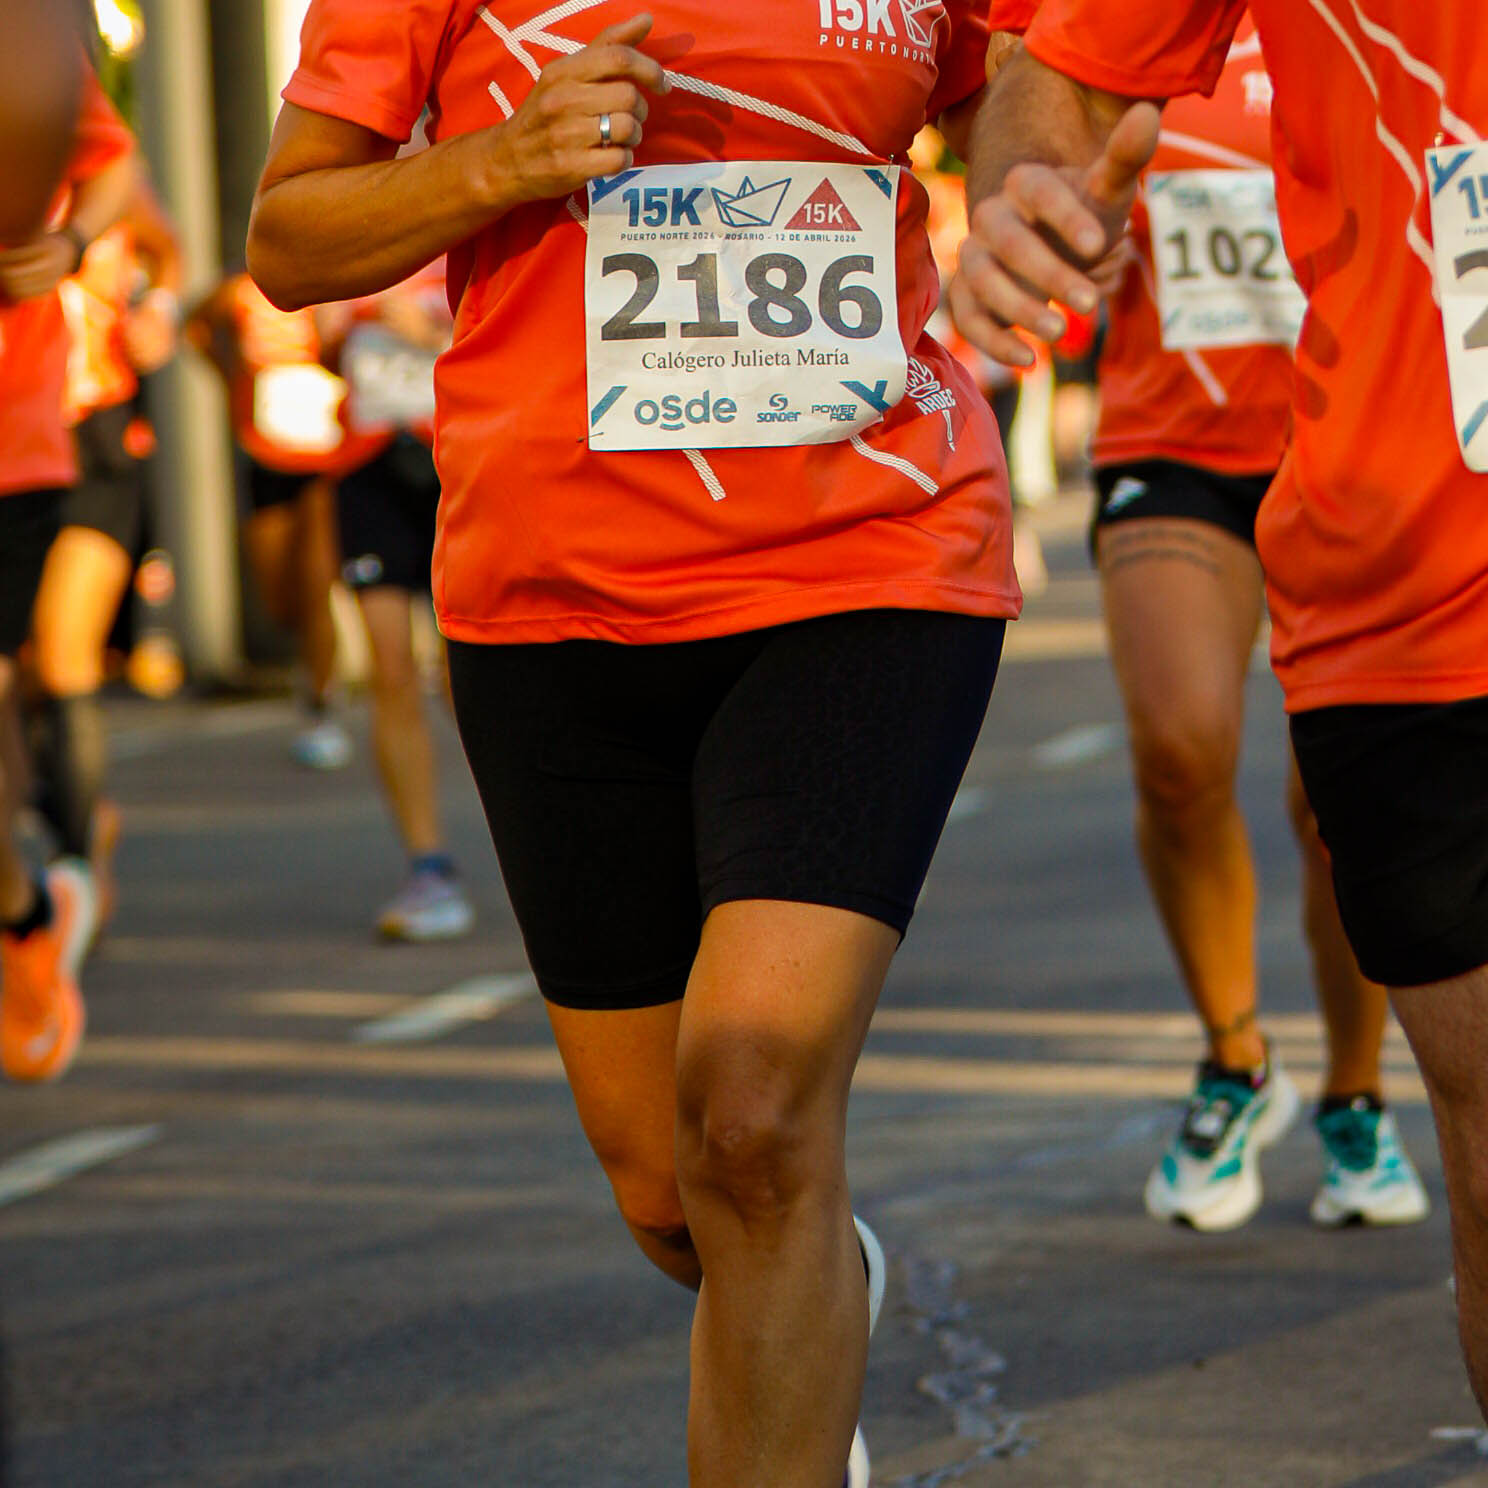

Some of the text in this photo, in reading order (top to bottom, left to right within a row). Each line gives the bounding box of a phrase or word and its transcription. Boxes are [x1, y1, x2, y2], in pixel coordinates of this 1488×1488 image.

[819, 34, 898, 56] PUERTO
[622, 187, 705, 227] 15K
[803, 202, 844, 225] 15K
[620, 232, 657, 242] PUERTO
[659, 232, 689, 241] NORTE
[724, 233, 766, 242] ROSARIO
[775, 233, 786, 242] 12
[789, 233, 801, 242] DE
[803, 233, 832, 243] ABRIL
[833, 234, 858, 244] 2026
[1164, 224, 1297, 281] 102
[600, 252, 884, 342] 2186
[641, 347, 850, 373] Calógero Julieta María
[633, 389, 738, 430] osde
[811, 404, 857, 415] POWER
[915, 388, 957, 417] ARDEC
